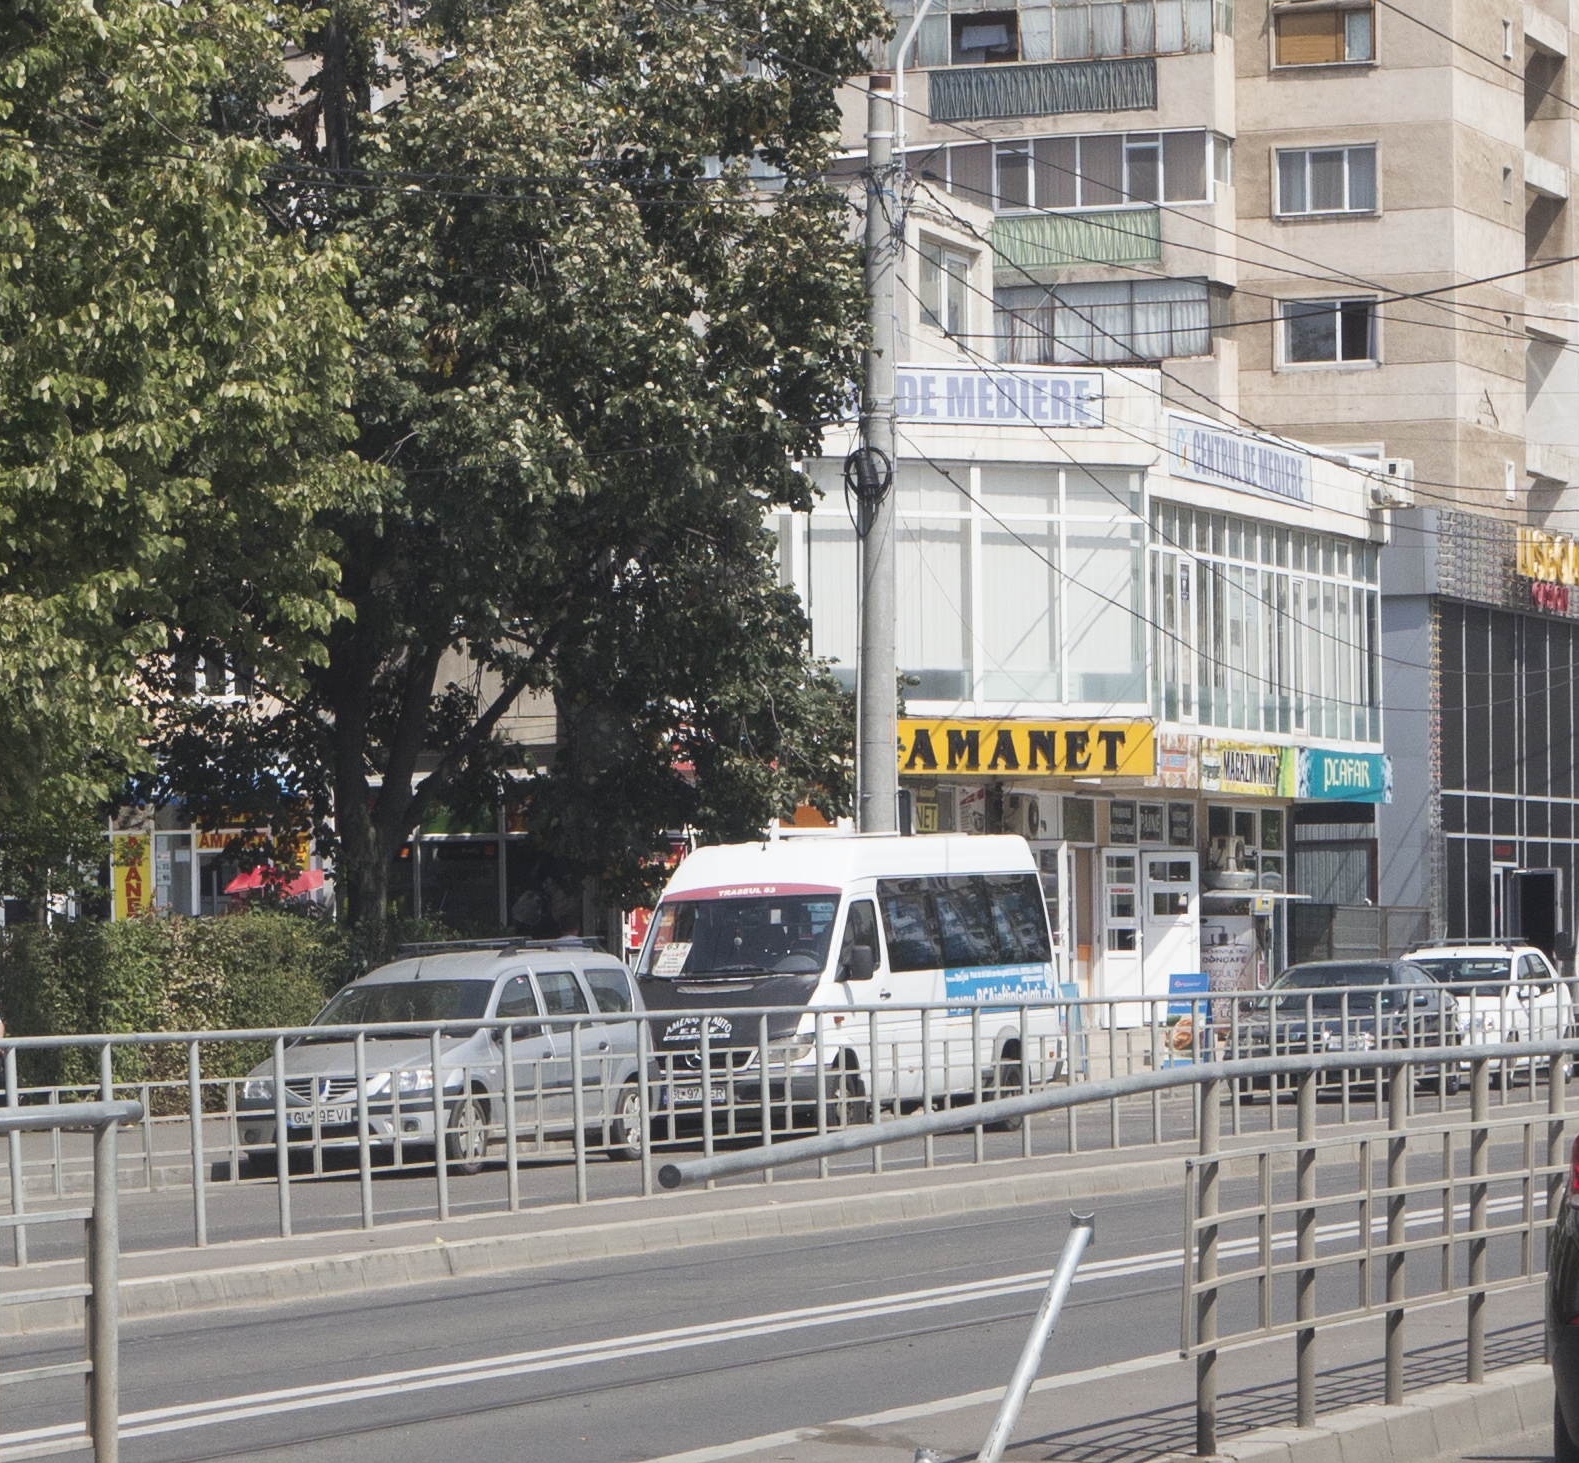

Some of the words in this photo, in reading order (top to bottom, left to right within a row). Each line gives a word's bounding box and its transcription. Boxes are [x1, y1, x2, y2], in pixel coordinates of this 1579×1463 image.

[896, 374, 937, 417] DE
[946, 376, 1091, 421] MEDIERE
[1193, 429, 1242, 483] CENTRUL
[1243, 443, 1257, 485] DE
[1258, 448, 1305, 501] MEDIERE
[904, 728, 1126, 772] AMANET
[1223, 750, 1256, 784] MAGAZIN
[1258, 754, 1277, 785] MIXT
[1323, 757, 1371, 793] PLAFAR
[718, 887, 761, 897] TRASEUL
[763, 886, 776, 894] 63
[294, 1111, 308, 1124] GL
